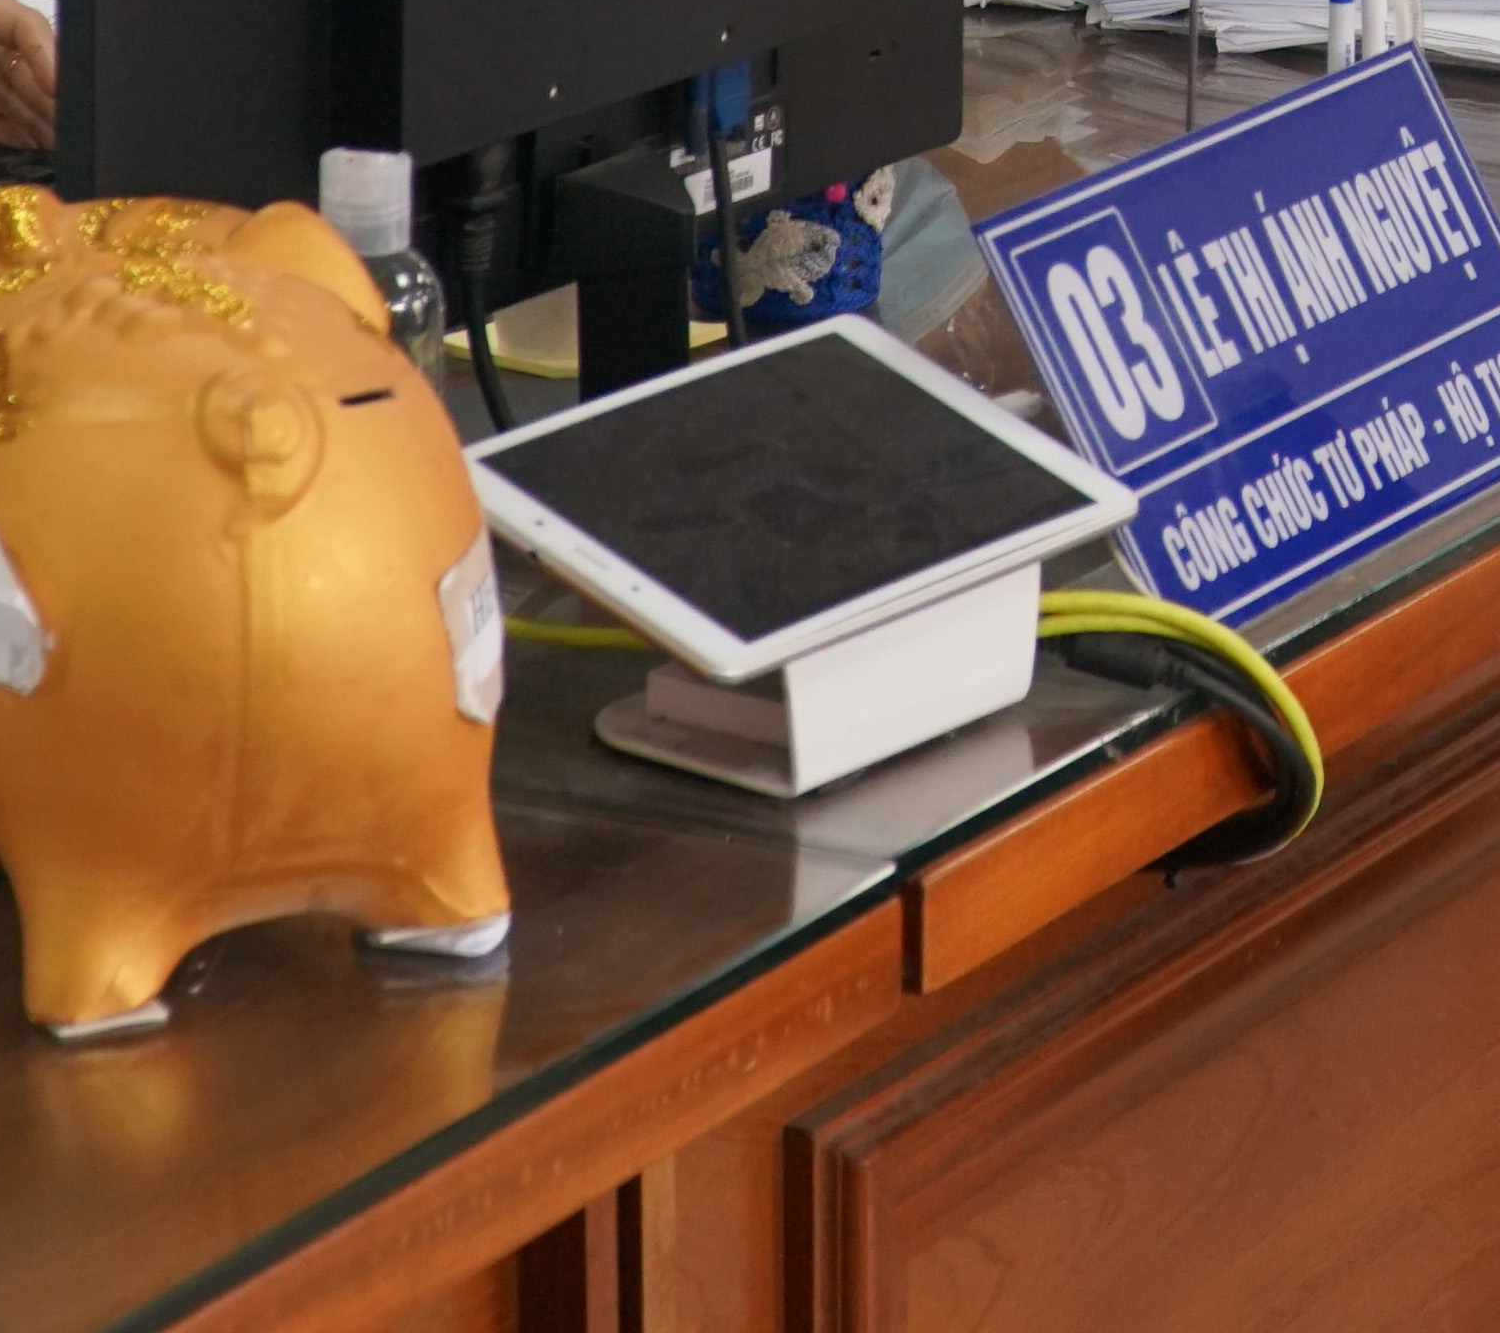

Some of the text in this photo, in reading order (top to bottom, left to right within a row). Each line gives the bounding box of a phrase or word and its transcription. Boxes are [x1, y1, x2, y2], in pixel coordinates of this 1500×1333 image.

[1046, 244, 1186, 441] 03
[1157, 127, 1482, 380] LÊ THỊ ÁNH NGUYỆT
[1161, 494, 1258, 593] CÔNG
[1242, 452, 1329, 549] CHỨC
[1312, 429, 1367, 515] TƯ
[1350, 395, 1432, 491] PHÁP
[1437, 361, 1496, 448] HỘ
